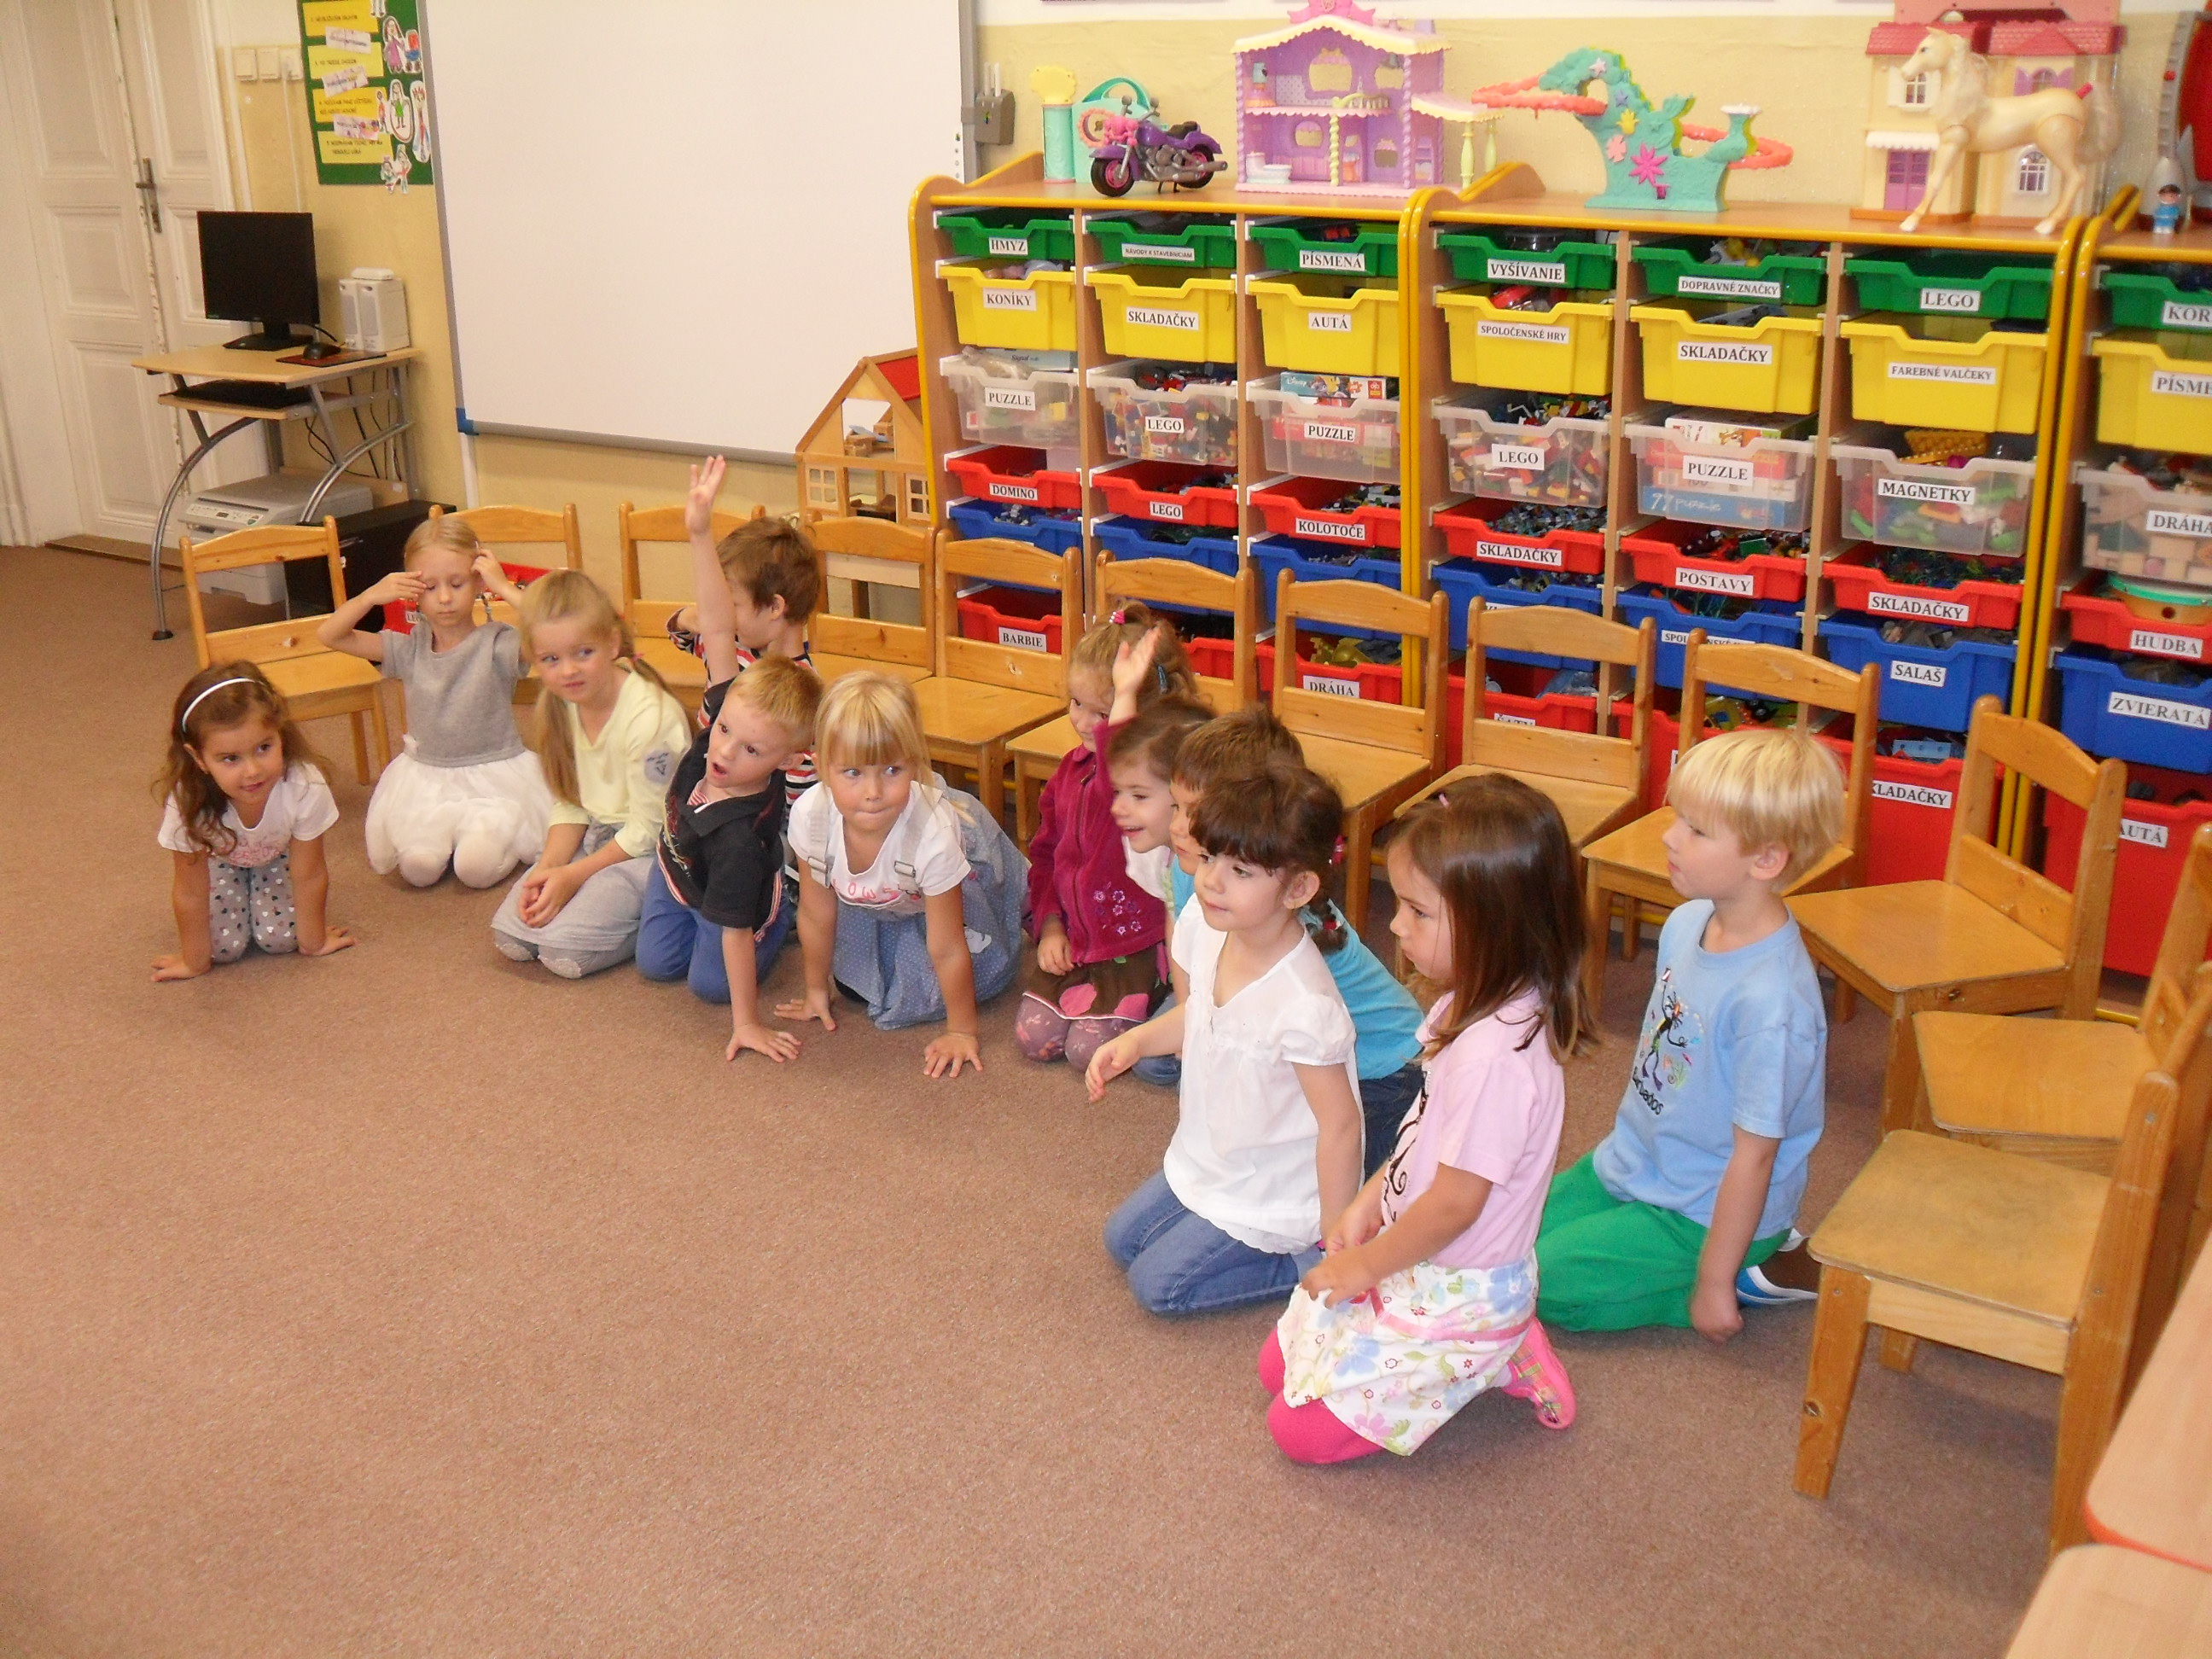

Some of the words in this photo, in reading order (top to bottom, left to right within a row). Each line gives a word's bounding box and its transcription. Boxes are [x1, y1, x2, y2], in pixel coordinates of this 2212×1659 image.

[991, 239, 1027, 253] HMYZ
[1302, 252, 1362, 269] PÍSMENÁ
[1490, 261, 1563, 281] VYŠÍVANIE
[1681, 280, 1736, 293] DOPRAVNÉ
[1738, 282, 1778, 295] ZNAČKY
[987, 291, 1032, 306] KONÍKY
[1924, 291, 1974, 308] LEGO
[1128, 311, 1196, 328] SKLADAČKY
[1312, 315, 1348, 329] AUTÁ
[1481, 325, 1545, 340] SPOLOČENSKÉ
[1546, 331, 1567, 341] HRY
[1680, 345, 1768, 363] SKLADAČKY
[1891, 365, 1941, 377] FAREBNÉ
[1943, 368, 1993, 381] VALČEKY
[989, 392, 1032, 406] PUZZLE
[1148, 416, 1182, 431] LEGO
[1308, 425, 1353, 441] PUZZLE
[1499, 451, 1539, 465] LEGO
[1688, 463, 1748, 480] PUZZLE
[992, 484, 1035, 499] DOMINO
[1883, 481, 1971, 502] MAGNETKY
[1152, 503, 1181, 517] LEGO
[1299, 521, 1364, 538] KOLOTOČE
[1480, 544, 1558, 563] SKLADAČKY
[1679, 571, 1750, 592] POSTAVY
[1871, 596, 1964, 620] SKLADAČKY
[1003, 632, 1043, 648] BARBIE
[2134, 633, 2198, 655] HUDBA
[1895, 664, 1942, 683] SALAŠ
[1309, 680, 1354, 696] DRÁHA
[2112, 697, 2205, 726] ZVIERATÁ
[1872, 783, 1947, 806] KLADAČKY
